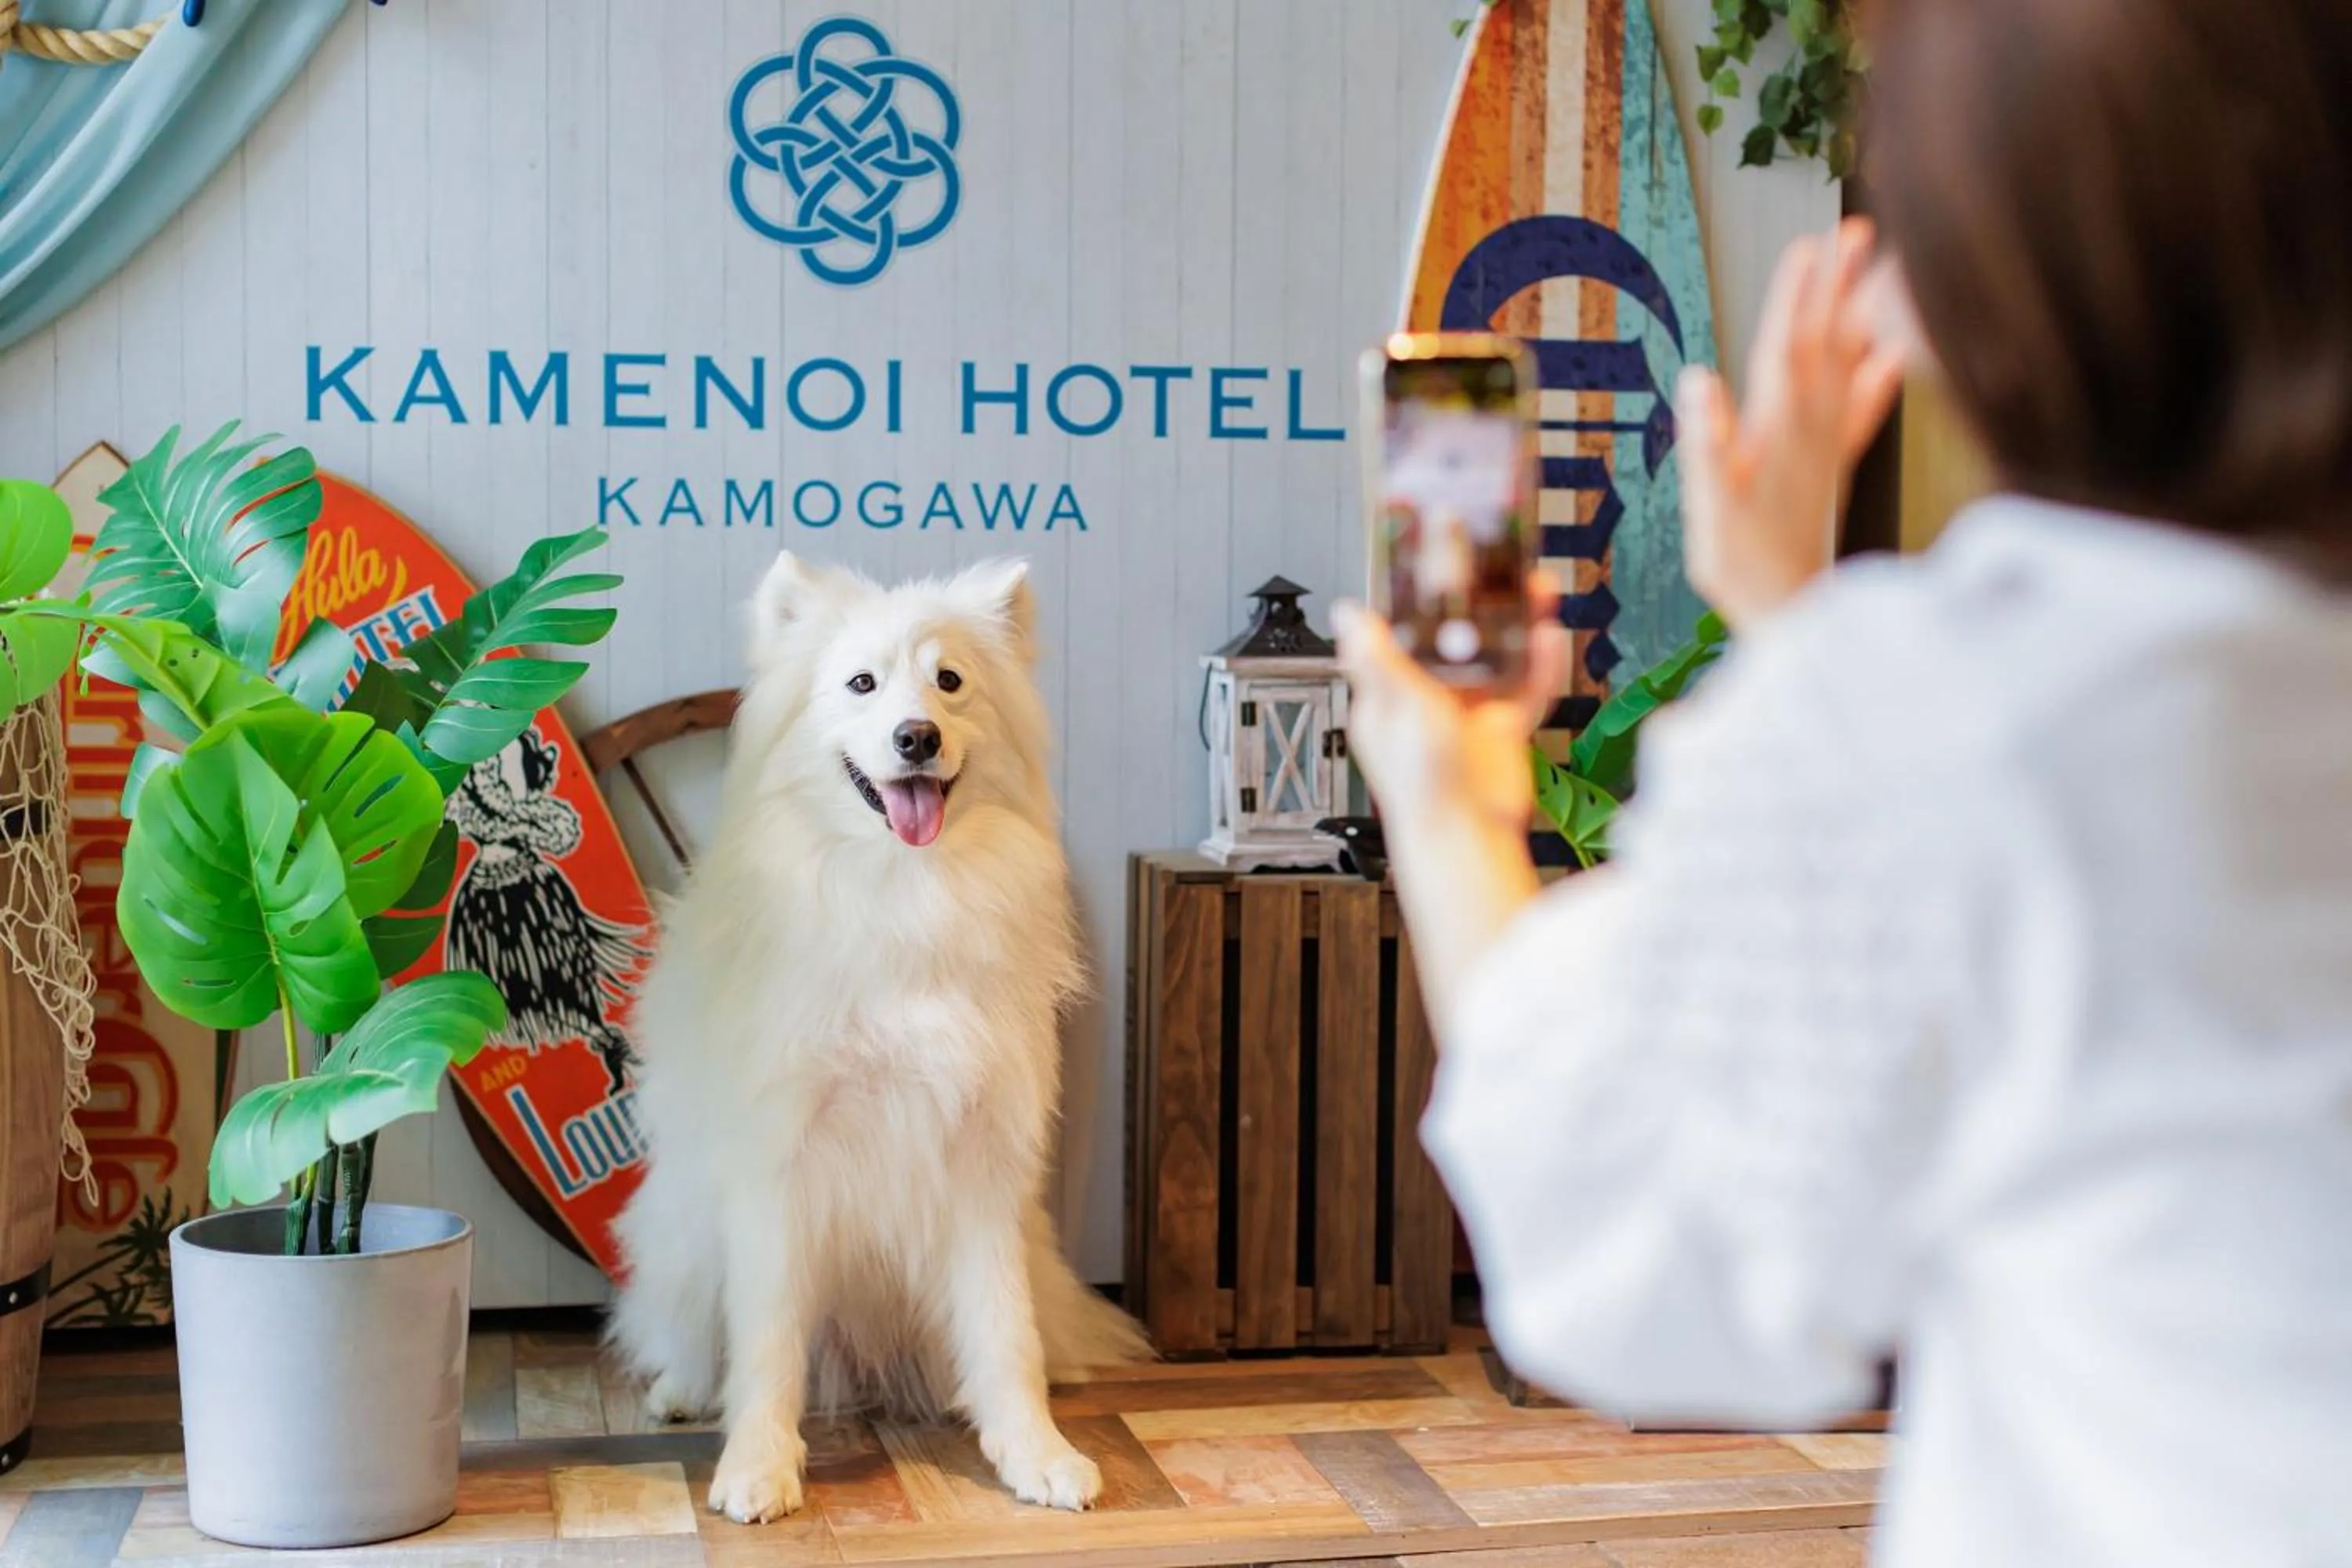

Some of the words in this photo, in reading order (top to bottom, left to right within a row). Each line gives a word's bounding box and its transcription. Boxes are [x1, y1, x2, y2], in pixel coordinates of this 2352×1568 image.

[306, 345, 902, 434] KAMENOI
[961, 361, 1347, 441] HOTEL
[598, 477, 1087, 531] KAMOGAWA
[479, 1054, 528, 1094] AND
